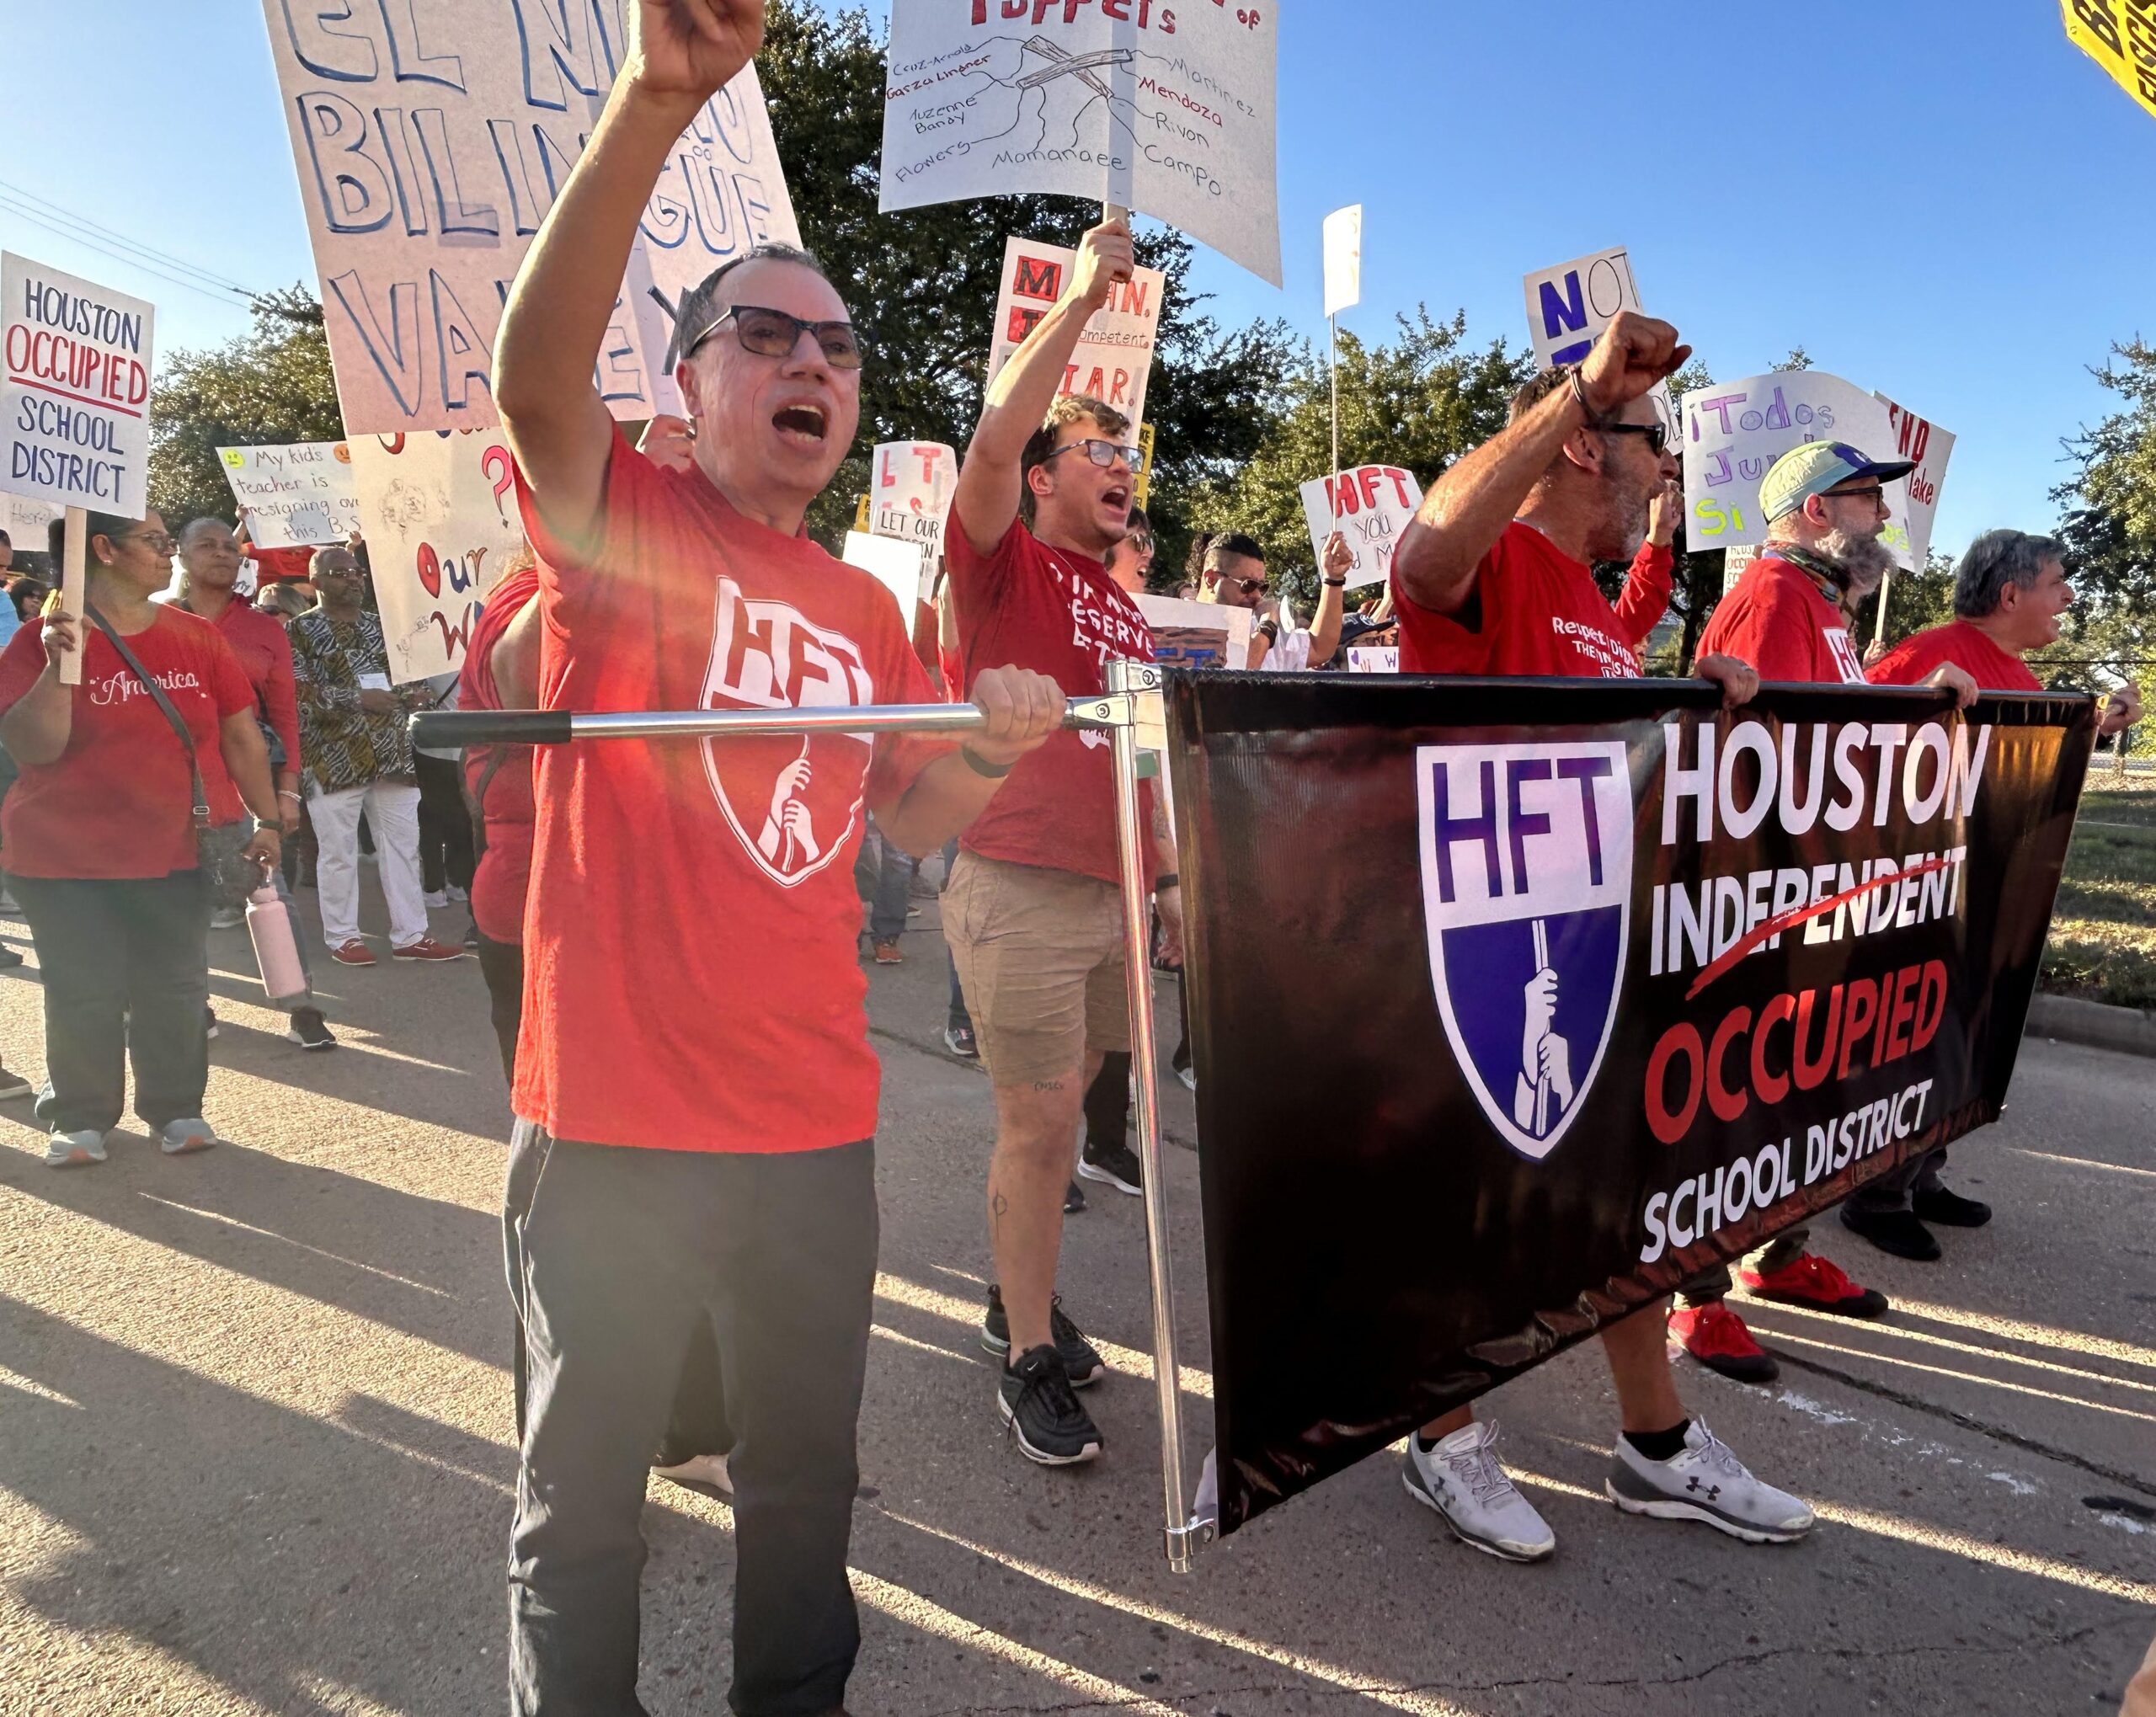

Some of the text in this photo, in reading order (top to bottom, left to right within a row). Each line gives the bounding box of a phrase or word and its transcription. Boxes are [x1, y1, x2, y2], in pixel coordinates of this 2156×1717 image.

[1138, 76, 1224, 129] Mendoza
[1144, 144, 1222, 196] Campo
[24, 277, 141, 354] HOUSTON
[1539, 252, 1640, 340] NOT
[6, 323, 147, 405] OCCUPIED
[17, 396, 125, 456] SCHOOL
[12, 440, 125, 504] DISTRICT
[237, 472, 328, 494] teacher is
[255, 451, 283, 472] My
[1324, 467, 1411, 519] HFT
[283, 523, 318, 541] this
[881, 510, 908, 532] LET
[915, 518, 939, 540] OUR
[1354, 514, 1393, 540] YOU
[416, 541, 487, 599] Our
[1661, 720, 1992, 845] HOUSTON
[1432, 757, 1613, 904] HFT
[1650, 845, 1967, 977] INDEPENDENT
[1644, 959, 1949, 1144] OCCUPIED
[1639, 1078, 1934, 1263] SCHOOL DISTRICT
